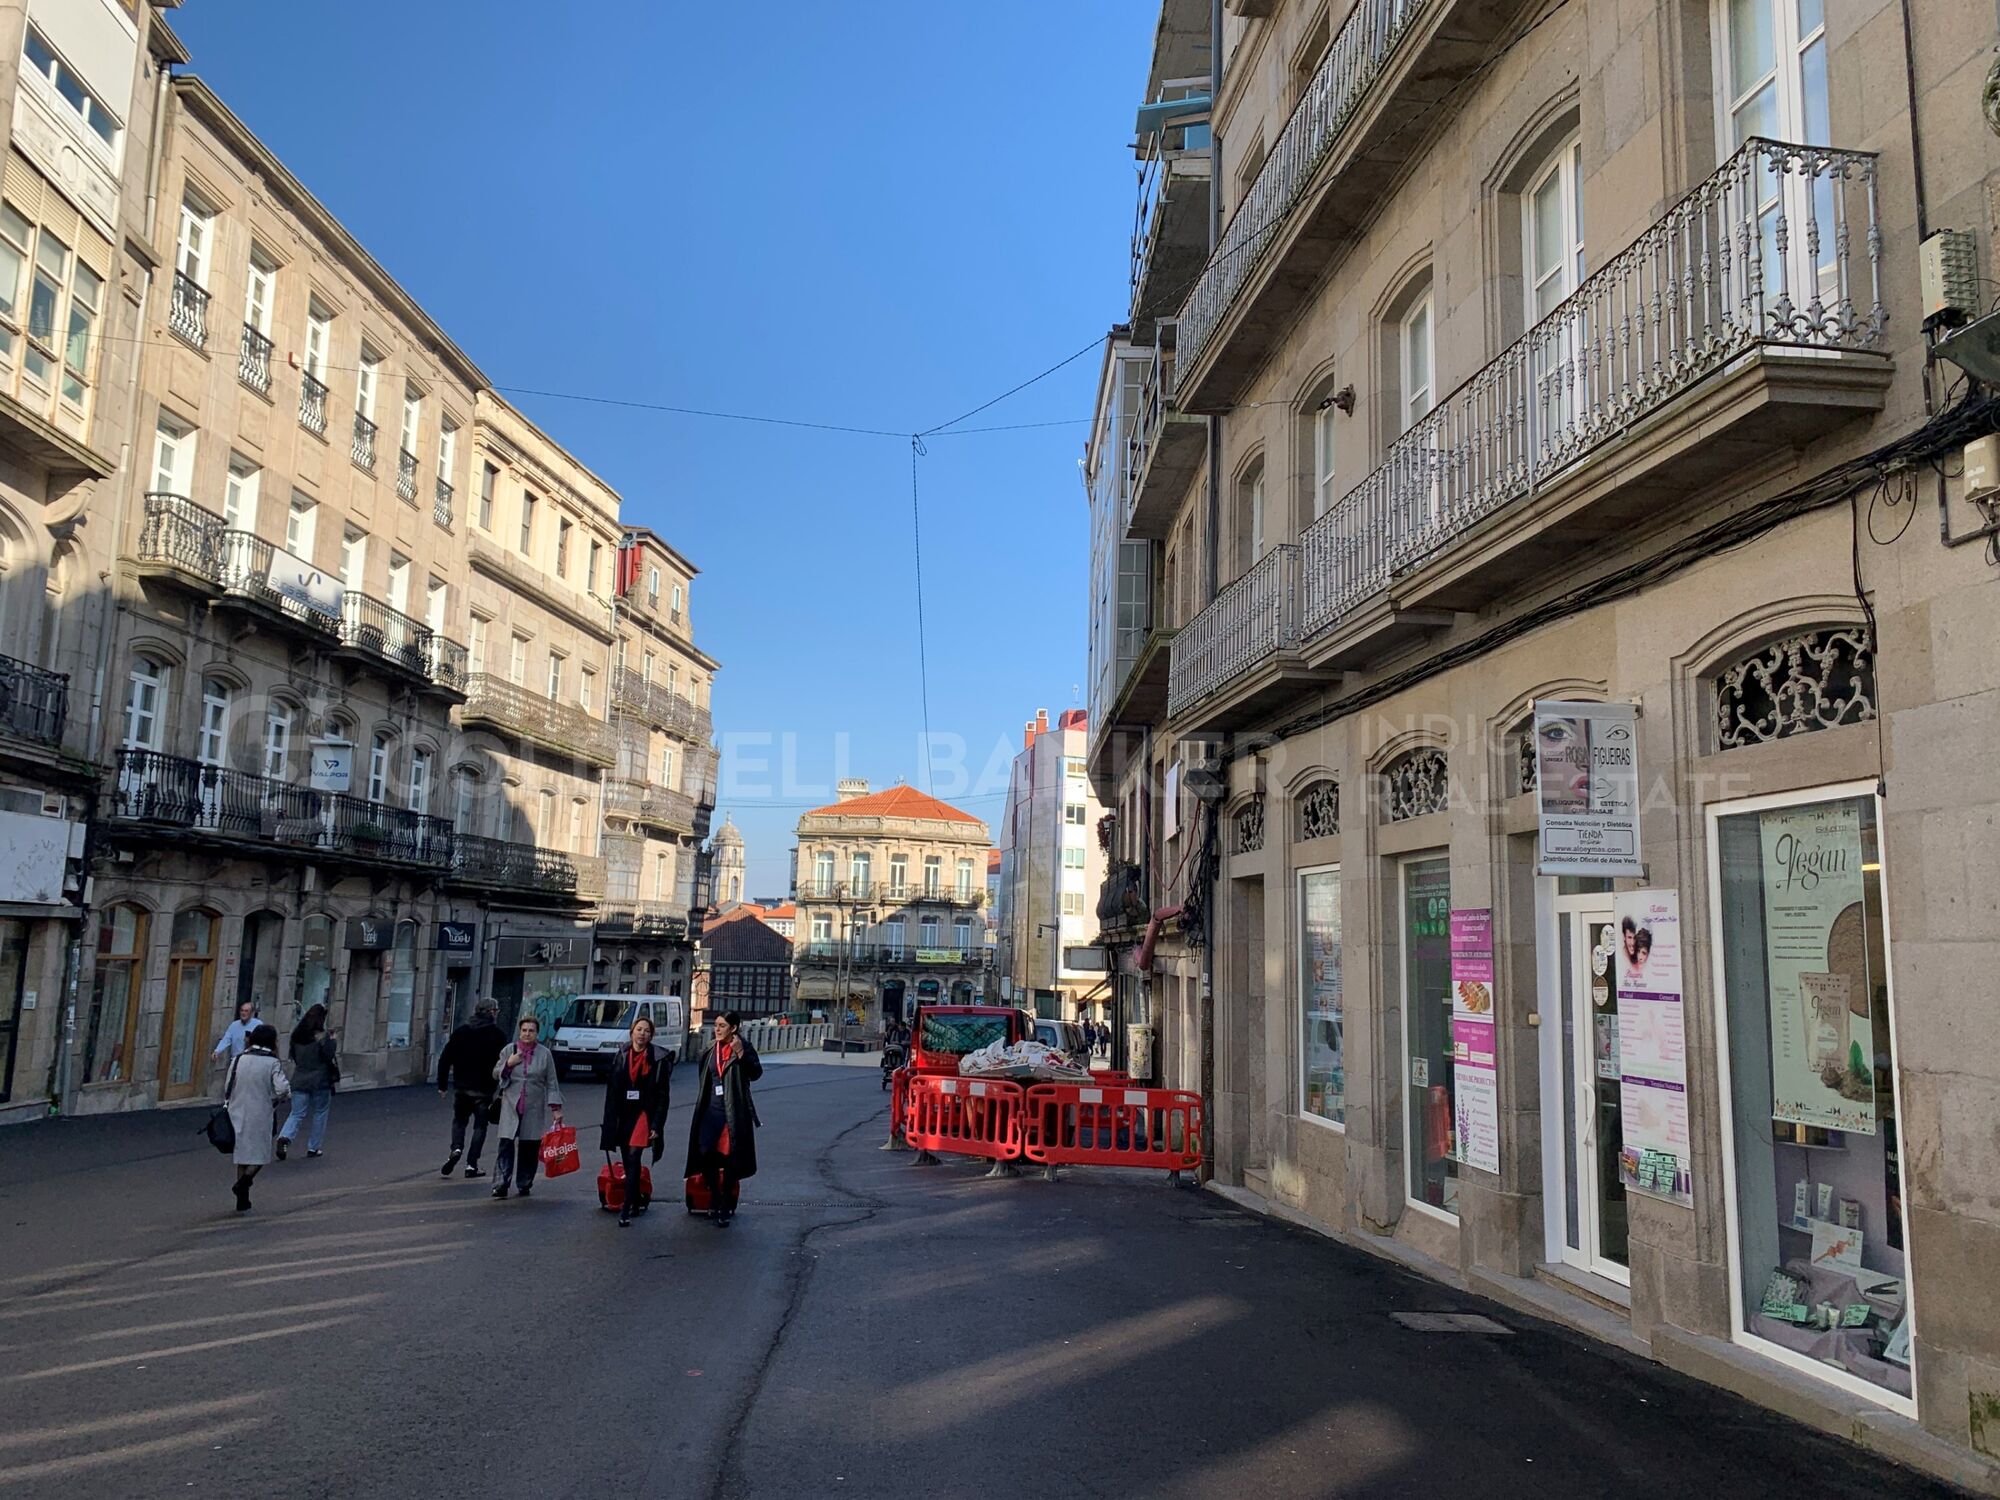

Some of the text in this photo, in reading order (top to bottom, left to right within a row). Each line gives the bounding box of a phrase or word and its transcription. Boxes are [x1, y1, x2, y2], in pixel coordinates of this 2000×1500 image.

[1565, 746, 1631, 767] ROSA FIGUEIRAS
[1607, 820, 1633, 828] Dietética
[1776, 833, 1846, 893] Vegan
